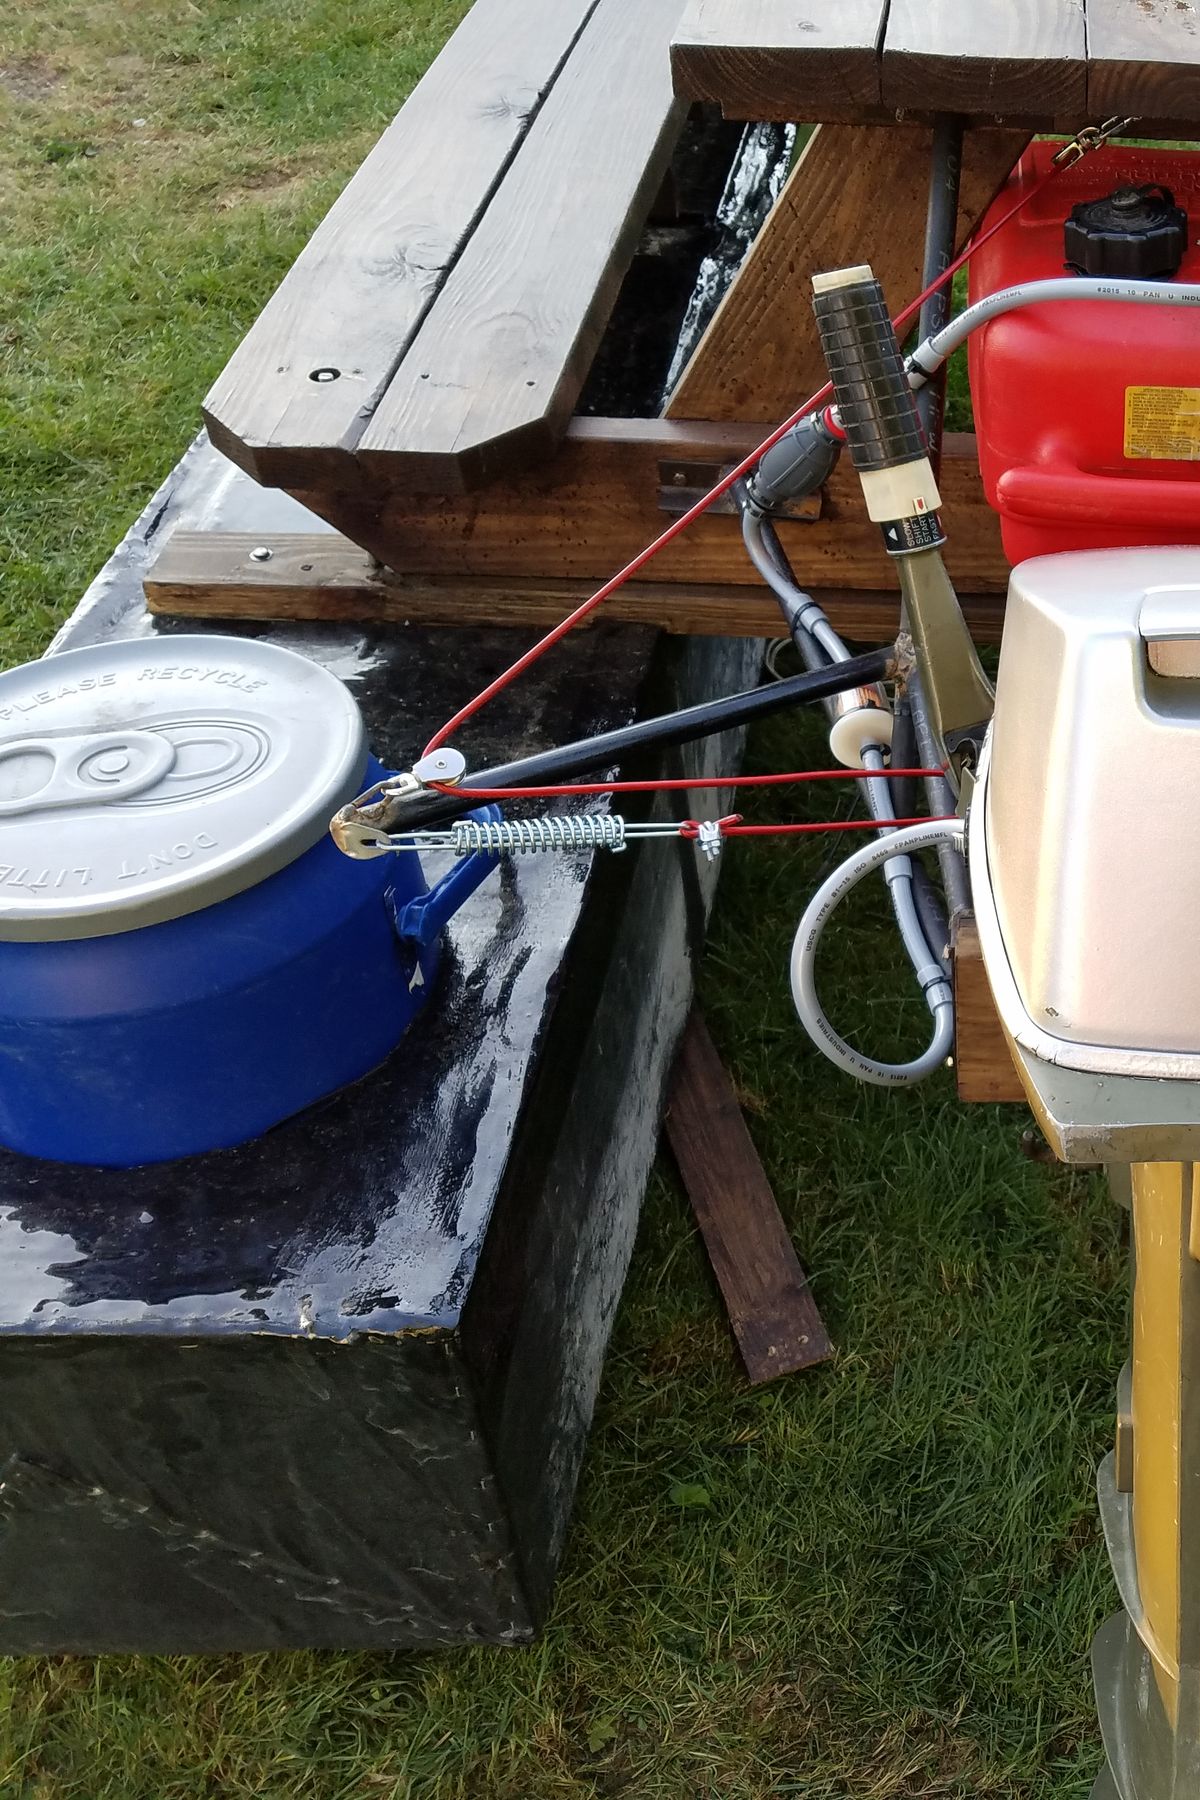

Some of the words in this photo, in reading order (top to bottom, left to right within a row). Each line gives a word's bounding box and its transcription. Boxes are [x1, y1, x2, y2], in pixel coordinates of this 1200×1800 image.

[1143, 290, 1160, 298] PAN
[902, 521, 915, 547] SLOW
[910, 517, 924, 544] SHIFT
[917, 515, 931, 542] START
[928, 517, 940, 540] FAST
[0, 672, 117, 720] PLEASE
[137, 666, 269, 694] RECYCLE
[117, 831, 219, 880] DON'T
[0, 863, 89, 888] LITTE
[816, 902, 830, 922] TYPE
[854, 862, 867, 874] ISO
[816, 1018, 847, 1056] INDUSTRIES
[859, 1063, 873, 1073] PAN
